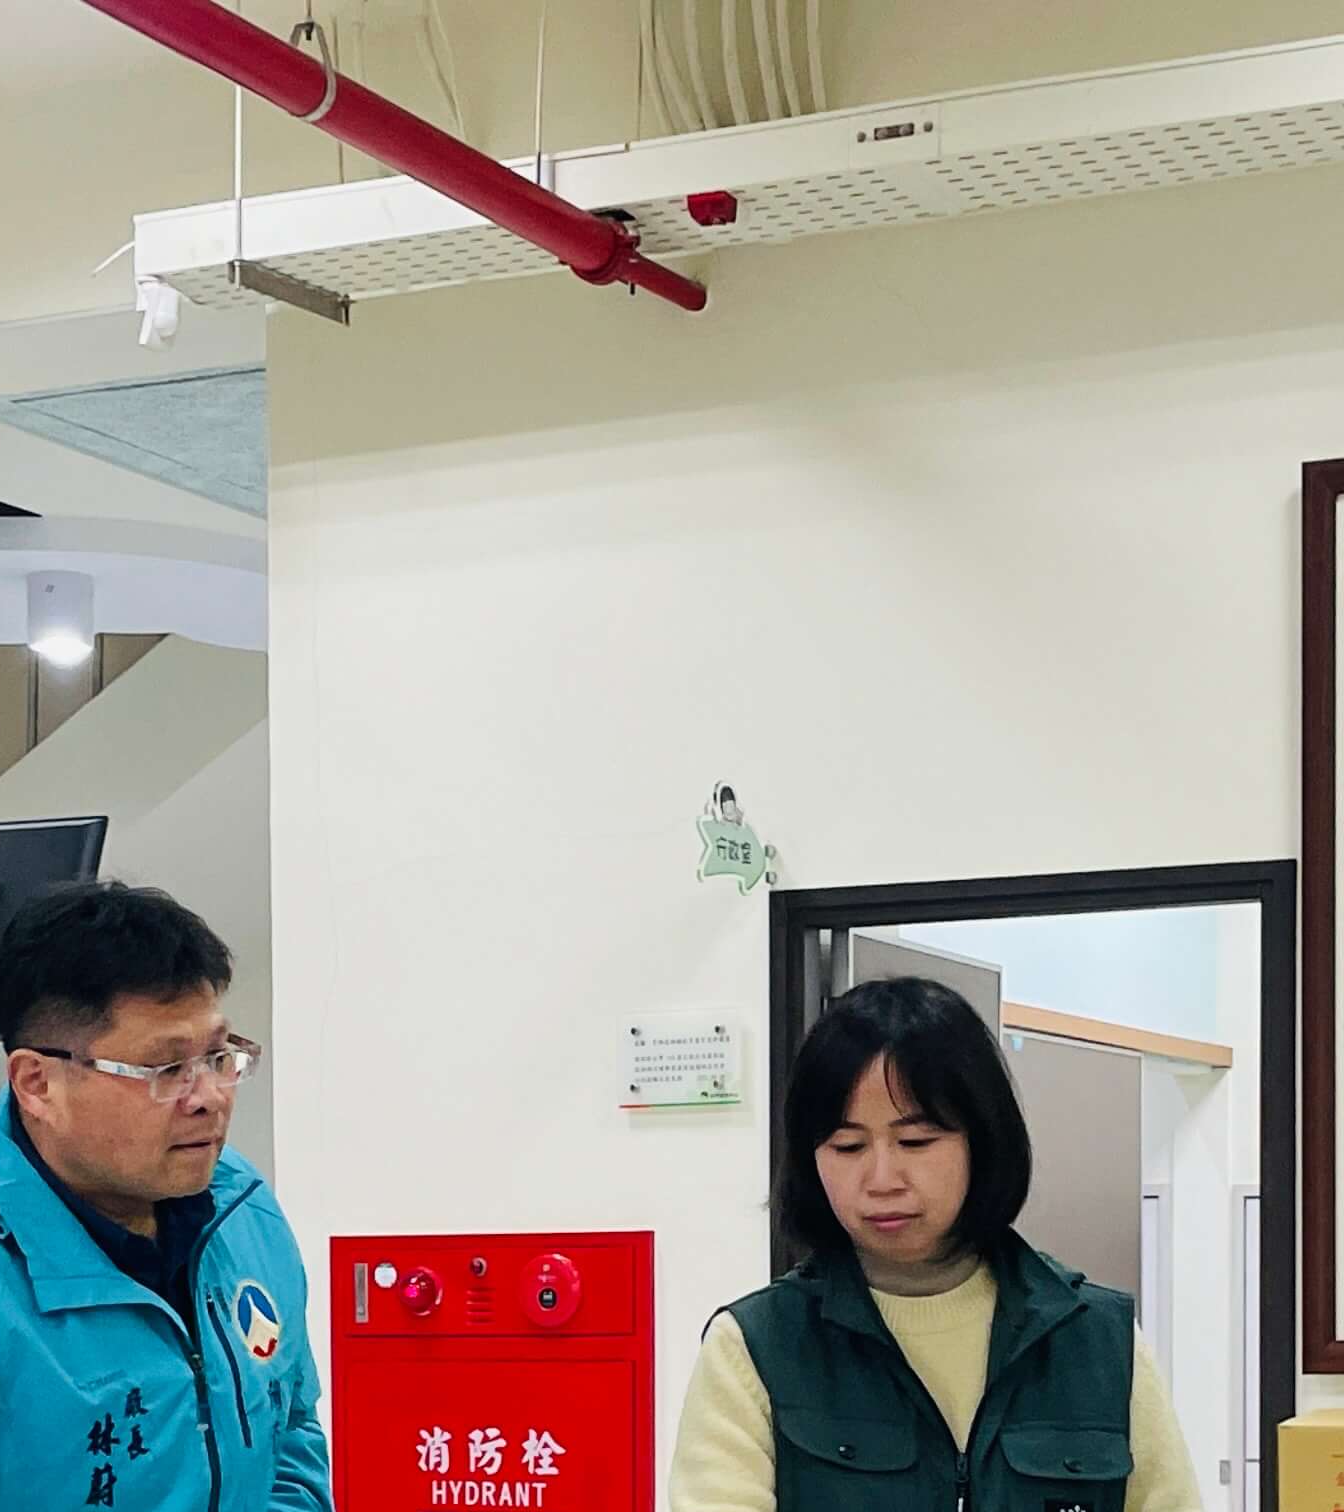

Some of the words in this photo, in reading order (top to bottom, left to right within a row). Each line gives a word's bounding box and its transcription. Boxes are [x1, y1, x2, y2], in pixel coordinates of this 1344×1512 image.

[415, 1426, 566, 1475] 消防栓
[431, 1480, 547, 1508] HYDRANT
